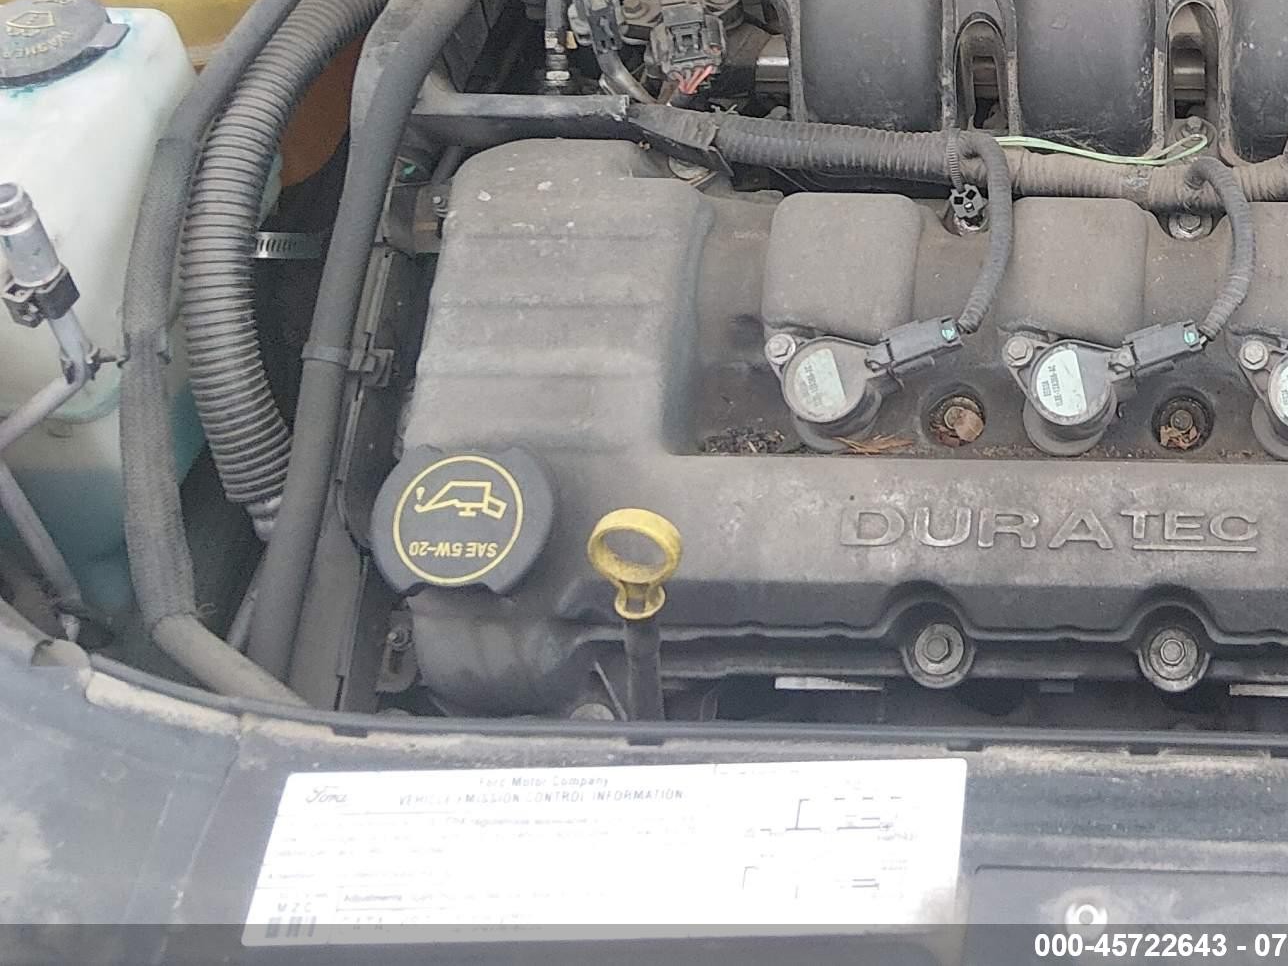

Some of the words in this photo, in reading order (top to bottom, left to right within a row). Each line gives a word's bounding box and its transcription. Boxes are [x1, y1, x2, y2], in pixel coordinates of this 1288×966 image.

[840, 505, 1259, 551] DURATEC
[408, 540, 463, 558] 5W-20
[465, 540, 498, 558] SAE
[553, 776, 609, 788] Company
[592, 790, 684, 801] INFORMATION
